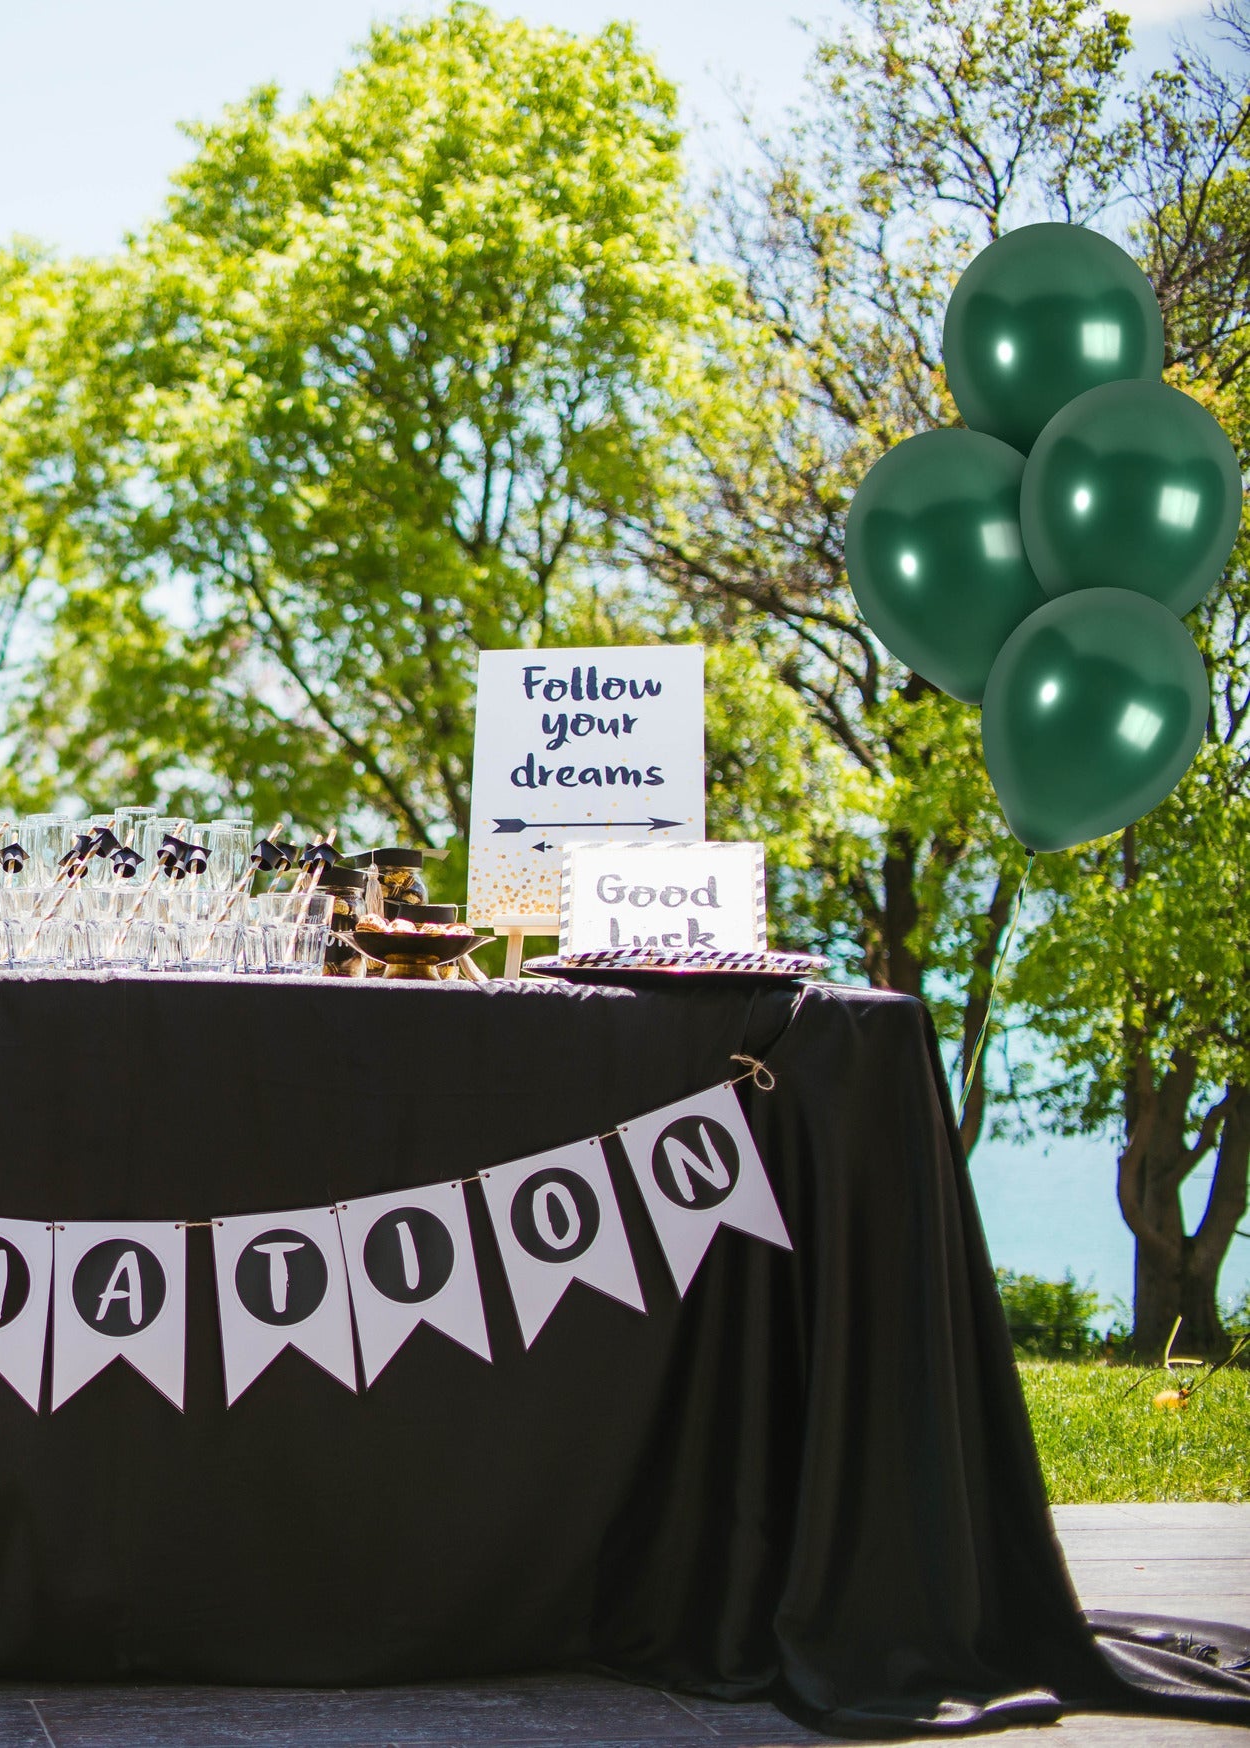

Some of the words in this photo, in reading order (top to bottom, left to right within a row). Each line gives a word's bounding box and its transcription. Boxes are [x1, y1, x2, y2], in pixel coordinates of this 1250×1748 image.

[522, 665, 662, 701] Follow
[541, 713, 638, 750] your
[510, 752, 665, 789] dreams
[596, 873, 722, 908] Good
[610, 917, 718, 950] Luck
